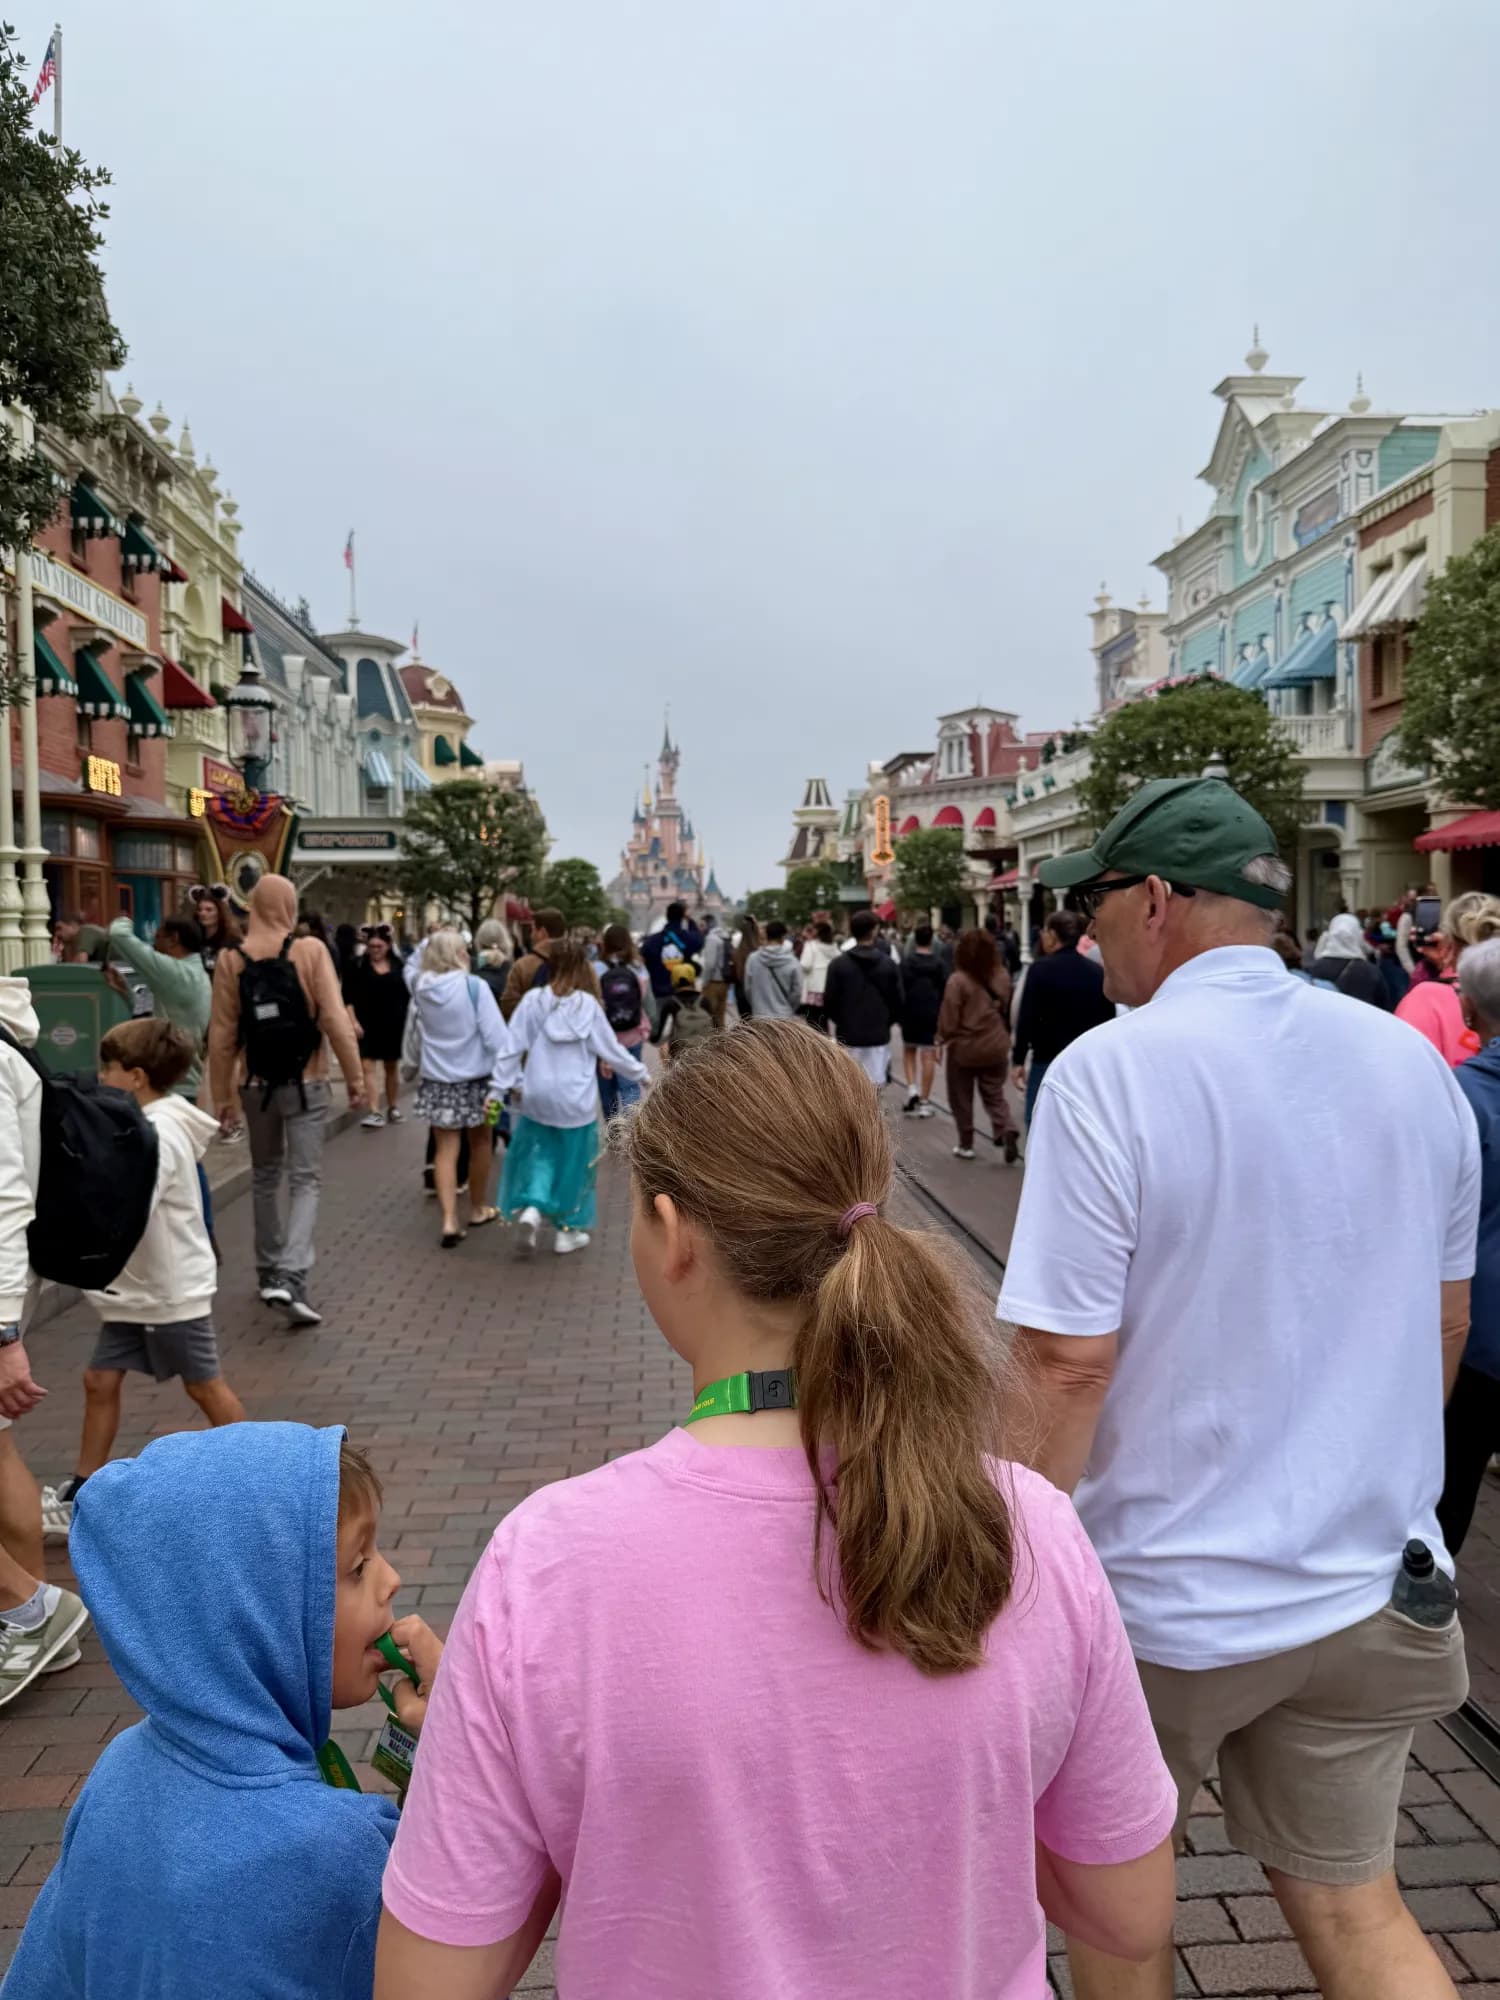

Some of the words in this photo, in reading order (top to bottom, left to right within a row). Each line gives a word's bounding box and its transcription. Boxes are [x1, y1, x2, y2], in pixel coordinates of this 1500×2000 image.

[54, 563, 92, 612] STREET
[95, 589, 134, 638] GAZETTE
[2, 1644, 41, 1669] N
